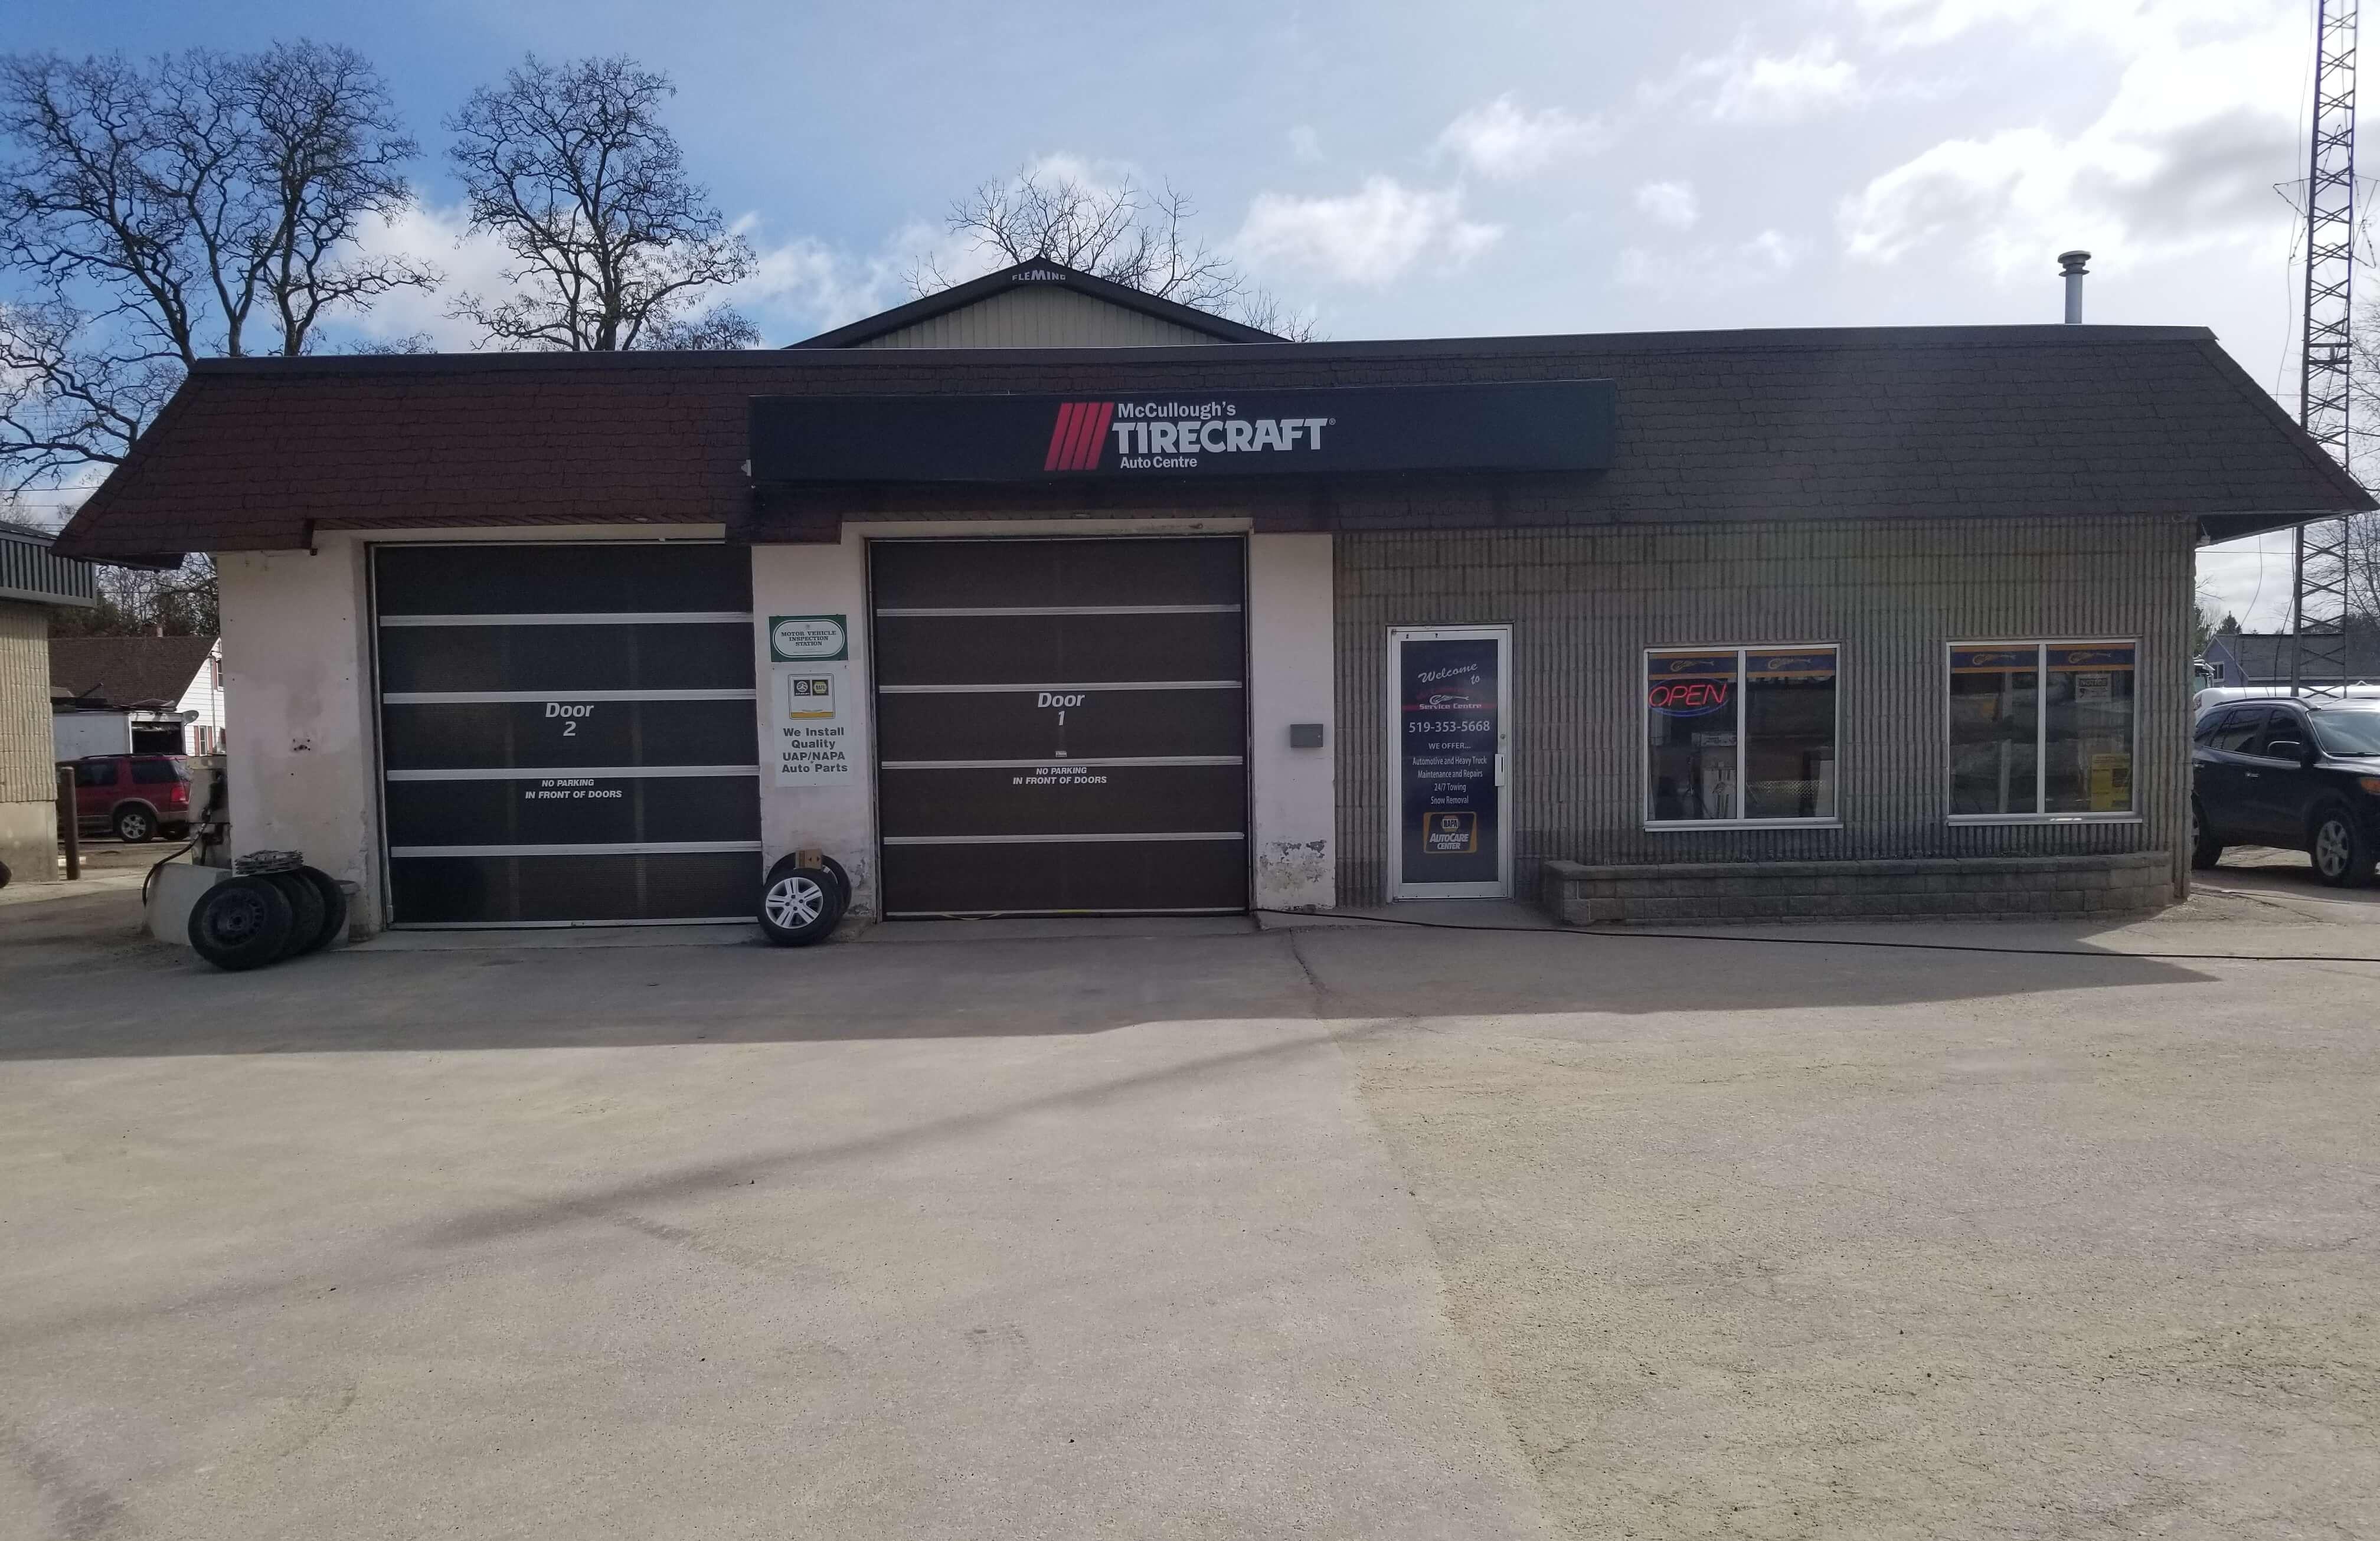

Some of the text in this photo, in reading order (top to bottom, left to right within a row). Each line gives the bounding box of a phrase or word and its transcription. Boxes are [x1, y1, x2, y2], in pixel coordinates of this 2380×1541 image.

[1012, 269, 1066, 281] FLEMING
[1118, 401, 1236, 420] McCullough's
[1120, 456, 1198, 469] Auto Centre
[1418, 663, 1478, 683] Welcome
[1470, 673, 1480, 685] to
[1038, 692, 1085, 708] Door
[1649, 683, 1727, 708] OPEN
[545, 702, 594, 718] Door
[1058, 711, 1065, 725] 1
[563, 721, 577, 736] 2
[783, 727, 844, 737] We Install
[1408, 720, 1490, 733] 519-353-5668
[791, 739, 836, 749] Quality
[783, 751, 845, 761] UAP/NAPA
[1413, 755, 1487, 766] Automotive and Heavy Truck
[782, 763, 848, 773] Auto Parts
[1418, 768, 1483, 779] Maintenance and Repairs
[1446, 783, 1466, 793] Towing
[573, 790, 586, 799] OF
[1431, 796, 1469, 804] Snow Removal
